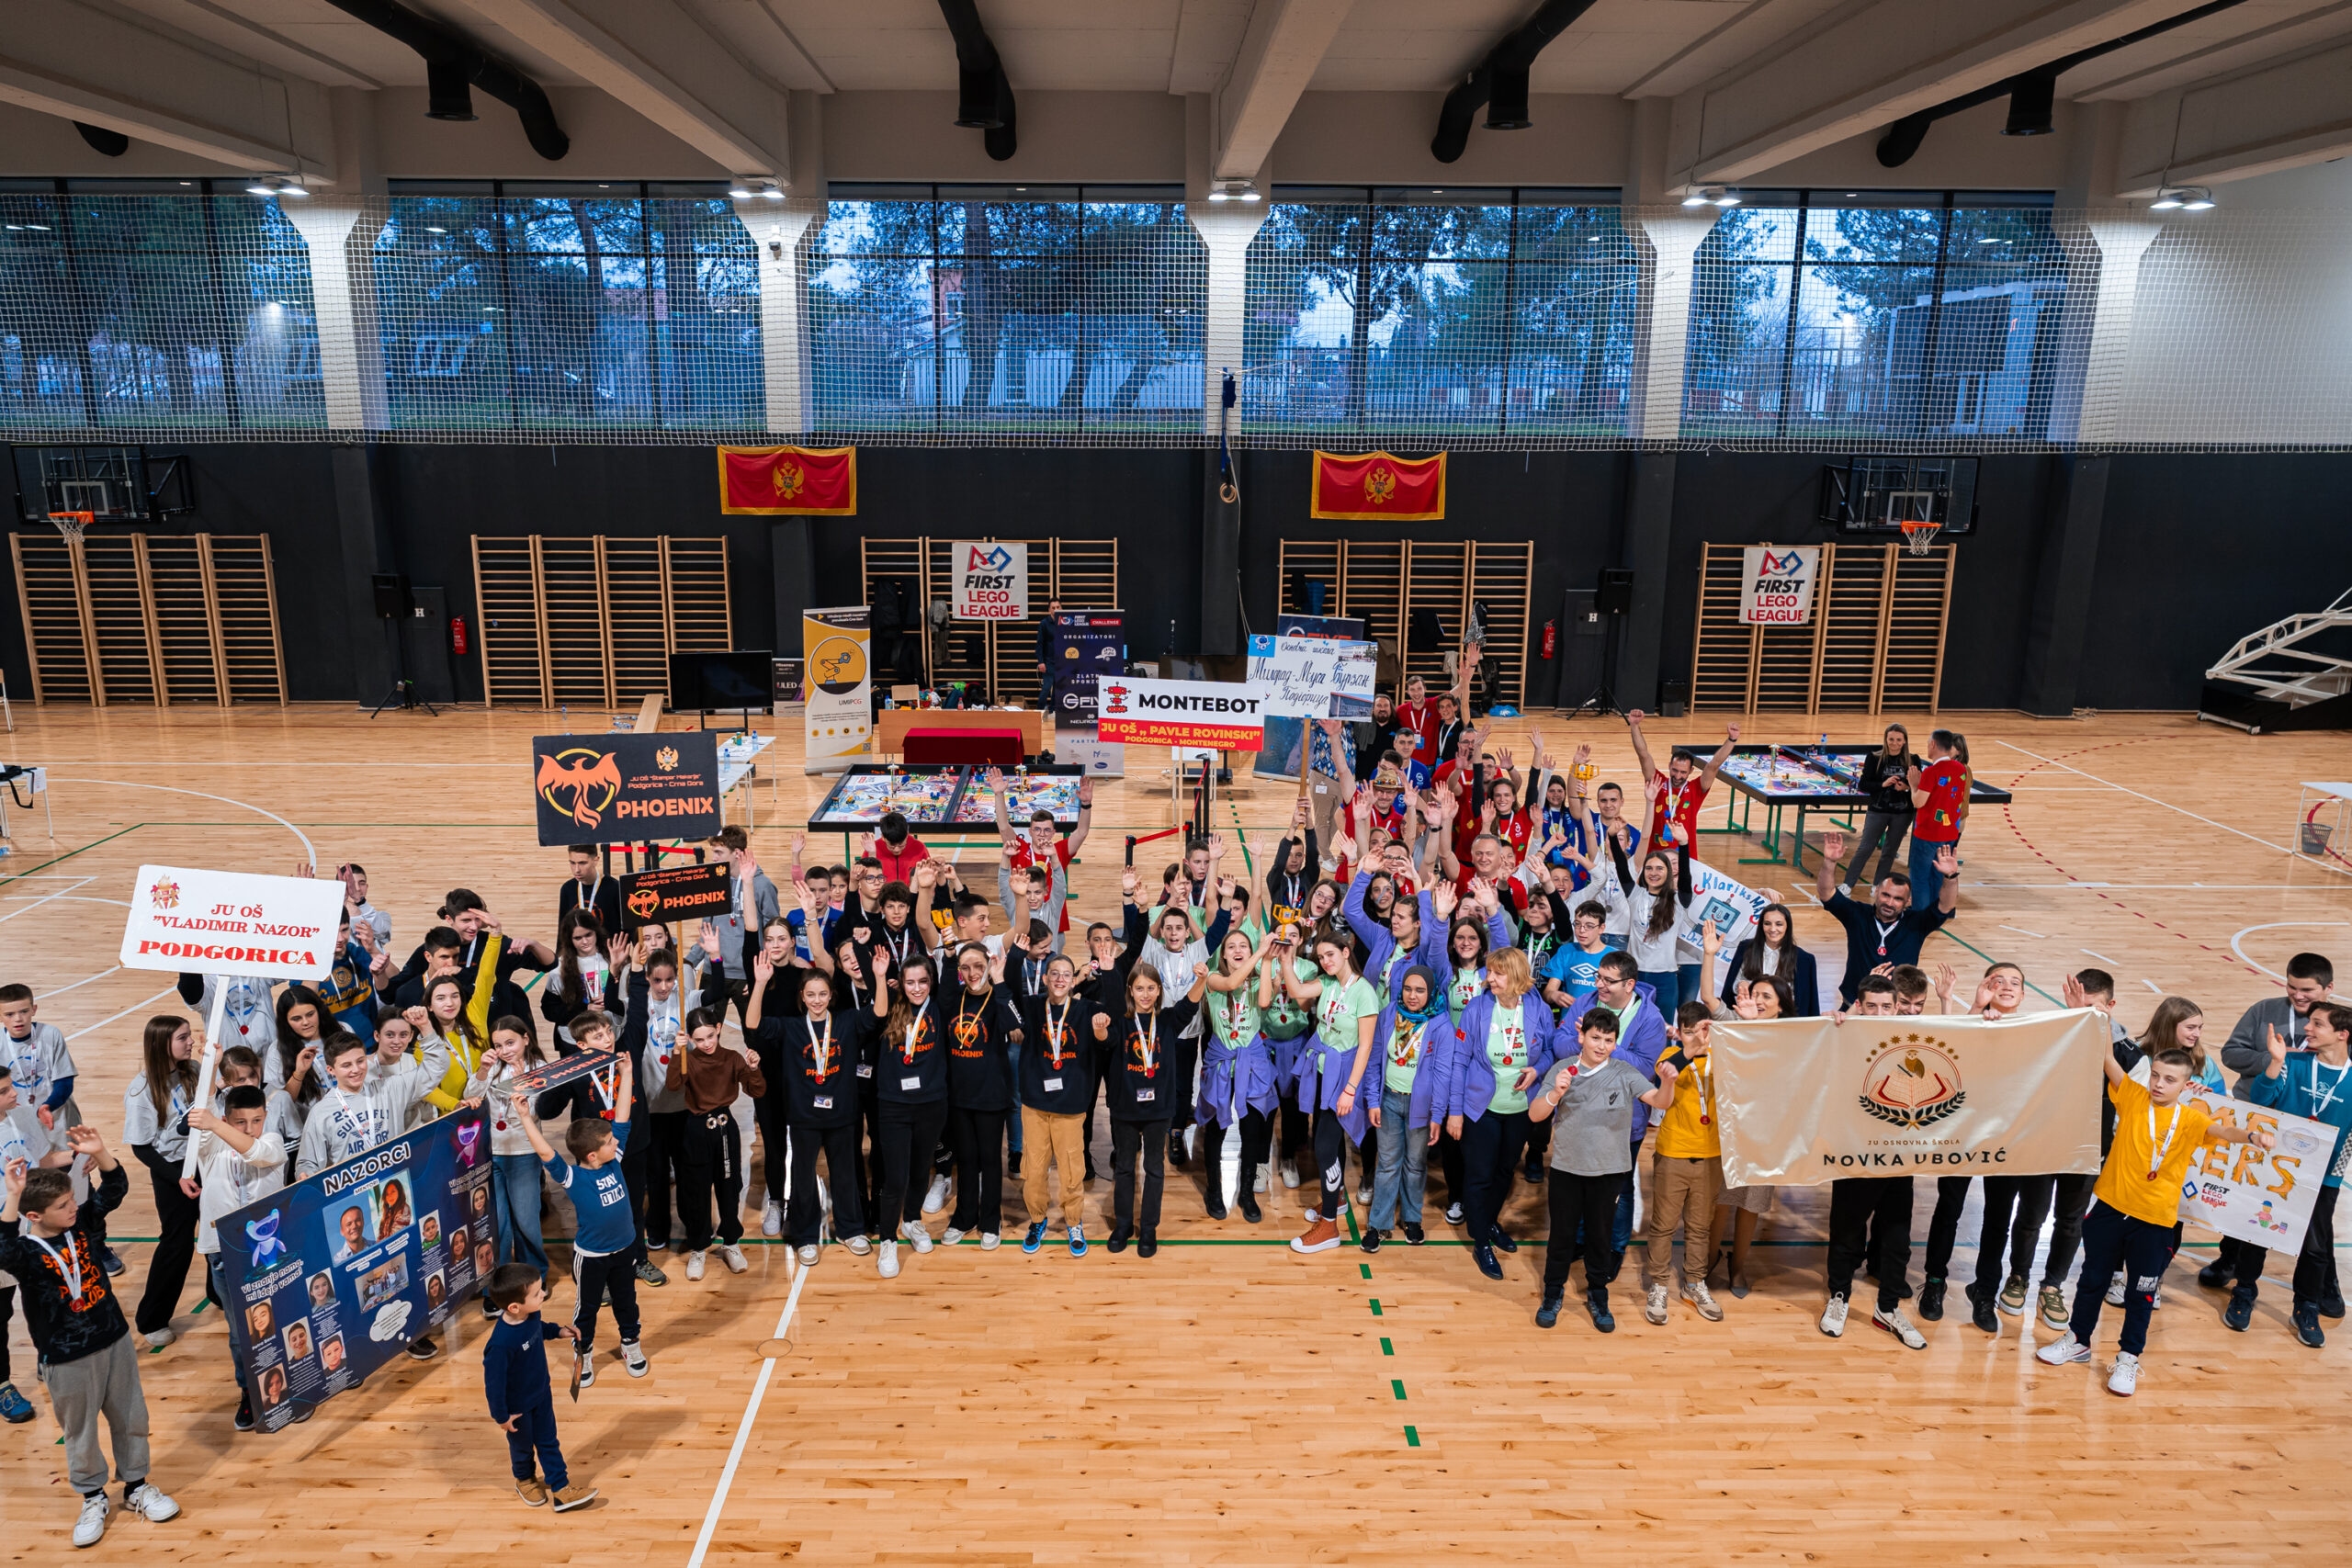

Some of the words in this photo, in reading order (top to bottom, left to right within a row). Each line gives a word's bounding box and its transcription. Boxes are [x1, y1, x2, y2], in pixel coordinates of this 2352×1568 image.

[965, 575, 1015, 589] FIRST
[1753, 580, 1805, 593] FIRST
[968, 591, 1010, 603] LEGO
[1757, 595, 1798, 607] LEGO
[414, 608, 424, 617] H
[960, 604, 1020, 617] LEAGUE
[1589, 613, 1598, 622] H
[1138, 694, 1261, 714] MONTEBOT
[1101, 722, 1117, 733] JU
[1120, 722, 1137, 734] OŠ
[1150, 725, 1190, 738] PAVLE
[1125, 736, 1172, 745] PODGORICA
[1179, 739, 1236, 749] MONTENEGRO
[616, 796, 714, 818] PHOENIX
[636, 879, 670, 887] Podgorica
[663, 890, 726, 909] PHOENIX
[211, 904, 234, 916] JU
[240, 904, 264, 919] OŠ
[137, 940, 317, 964] PODGORICA
[952, 1048, 983, 1057] PHOENIX
[347, 1140, 365, 1155] AIR
[1823, 1154, 1905, 1167] NOVKA
[1914, 1146, 2007, 1165] UBOVIĆ
[323, 1142, 411, 1196] NAZORCI
[354, 1179, 379, 1195] MENTORI
[596, 1172, 617, 1190] STAY
[2203, 1182, 2230, 1194] FIRST
[2201, 1195, 2227, 1208] LEAGUE
[252, 1271, 278, 1290] znanje
